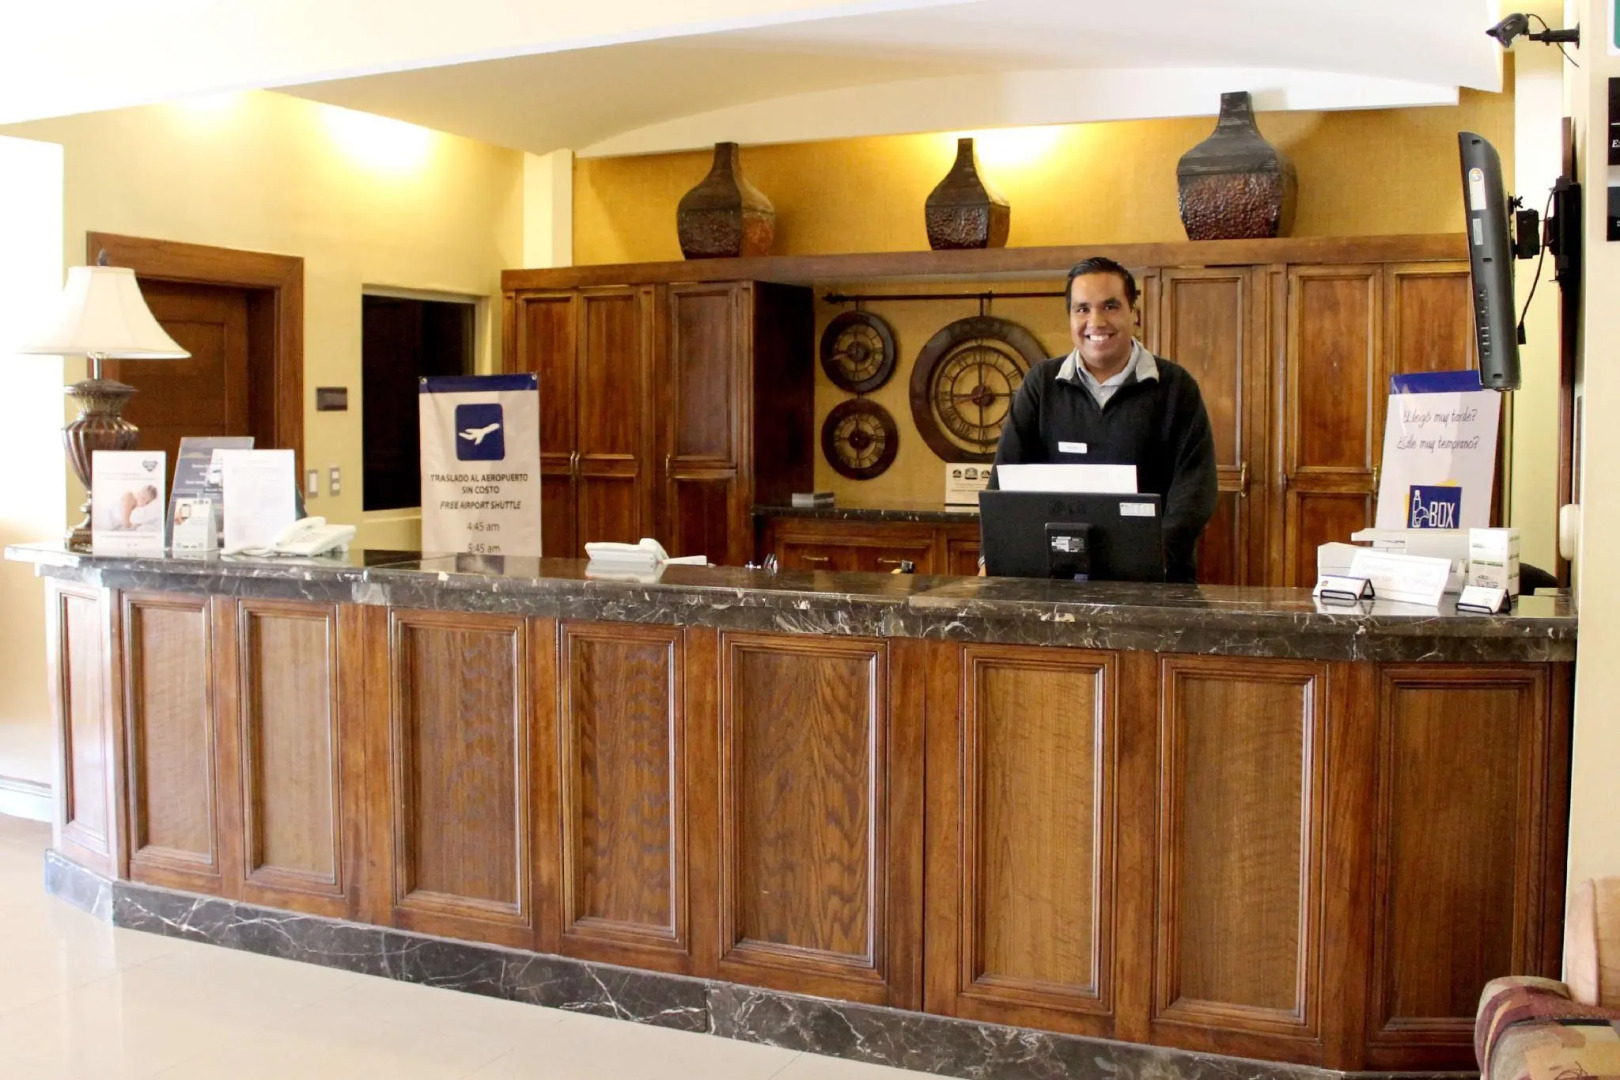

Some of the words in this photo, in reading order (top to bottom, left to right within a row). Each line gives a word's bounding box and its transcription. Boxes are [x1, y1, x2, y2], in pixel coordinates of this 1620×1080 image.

[1433, 413, 1450, 428] muy
[1451, 406, 1478, 423] tarde?
[1419, 440, 1436, 453] muy
[1438, 435, 1480, 455] temprano?
[430, 474, 469, 482] TRASLADO
[470, 474, 479, 482] AL
[481, 473, 528, 482] AEROPUERTO
[461, 486, 473, 494] SIN
[474, 485, 500, 494] COSTO
[440, 501, 459, 509] FREE
[459, 501, 490, 509] AIRPORT
[490, 501, 521, 509] SHUTTLE
[1429, 501, 1456, 528] BOX
[467, 521, 485, 531] 4:45
[486, 523, 500, 531] am
[487, 544, 501, 553] am
